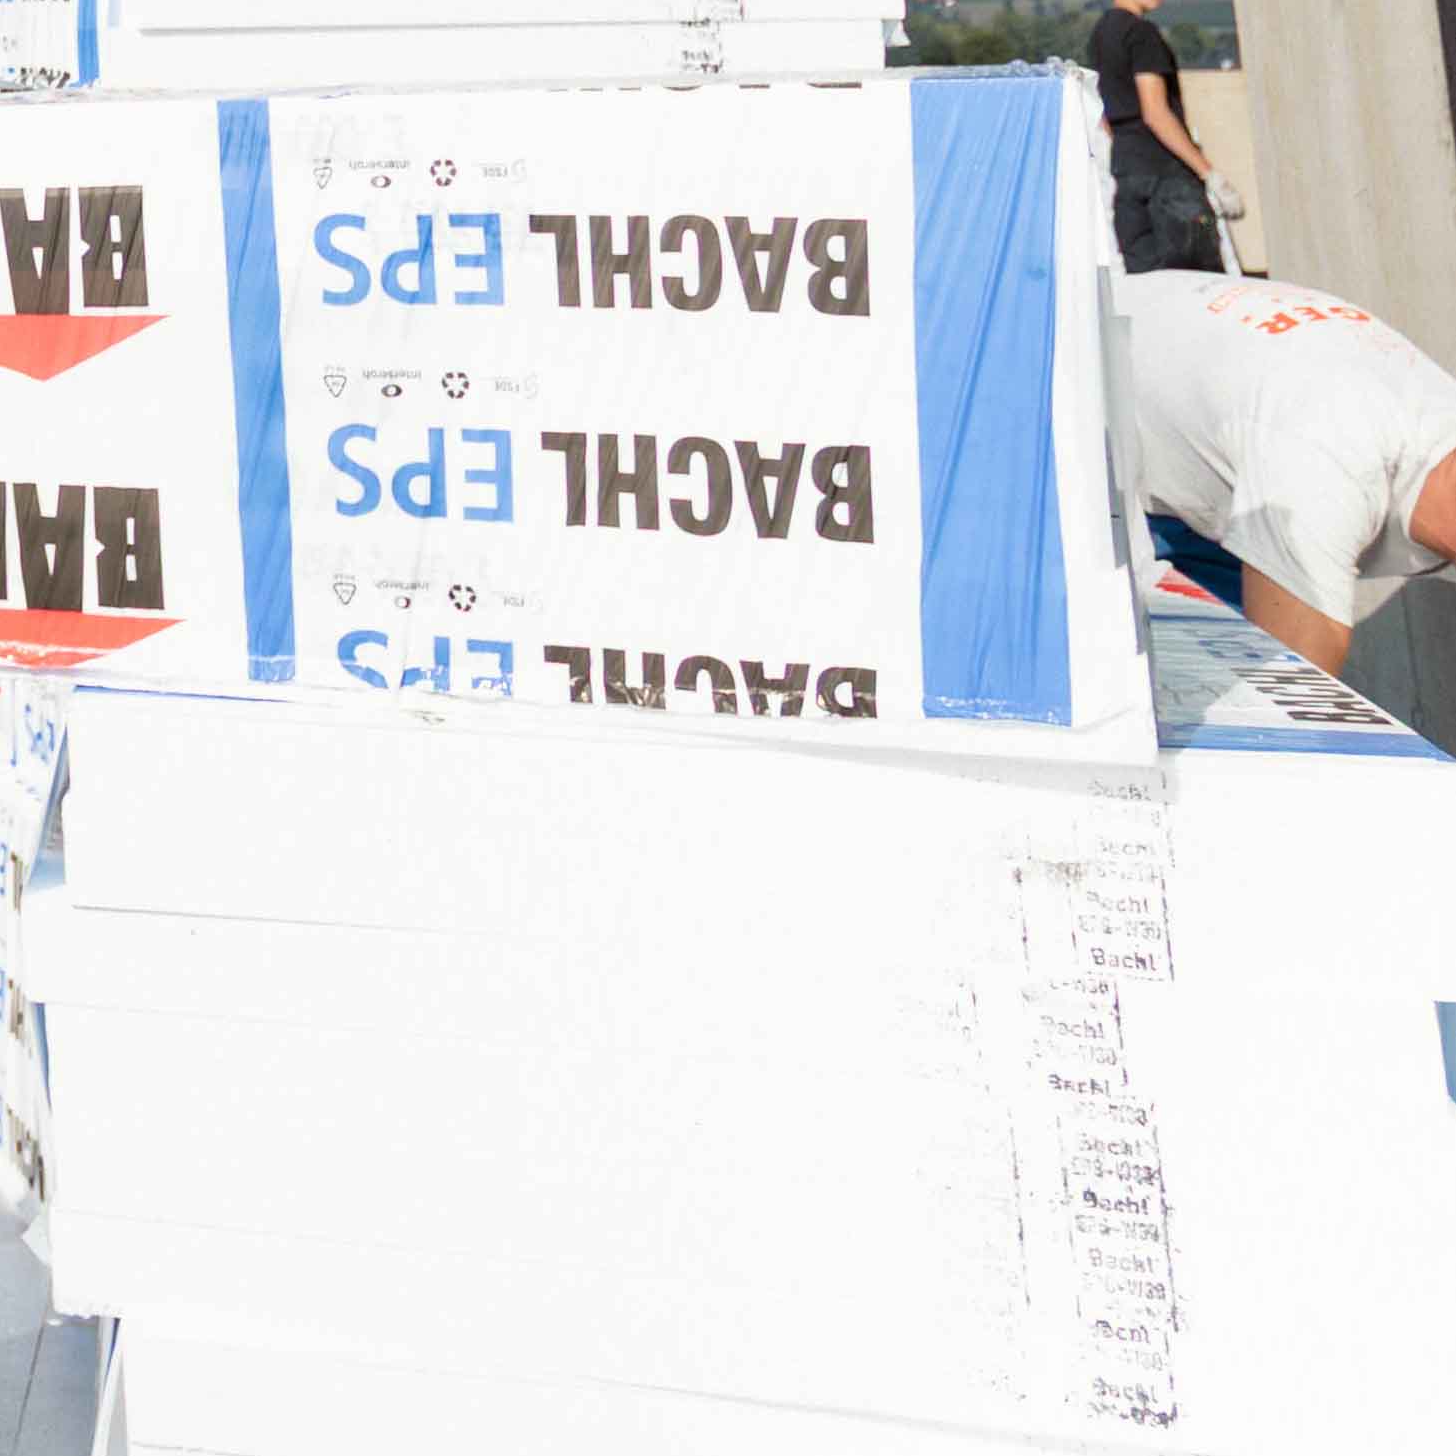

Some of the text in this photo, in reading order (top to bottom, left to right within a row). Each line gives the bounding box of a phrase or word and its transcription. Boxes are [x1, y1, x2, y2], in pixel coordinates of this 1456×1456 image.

[312, 212, 871, 317] BACHL EPS
[326, 423, 875, 544] BACHL EPS
